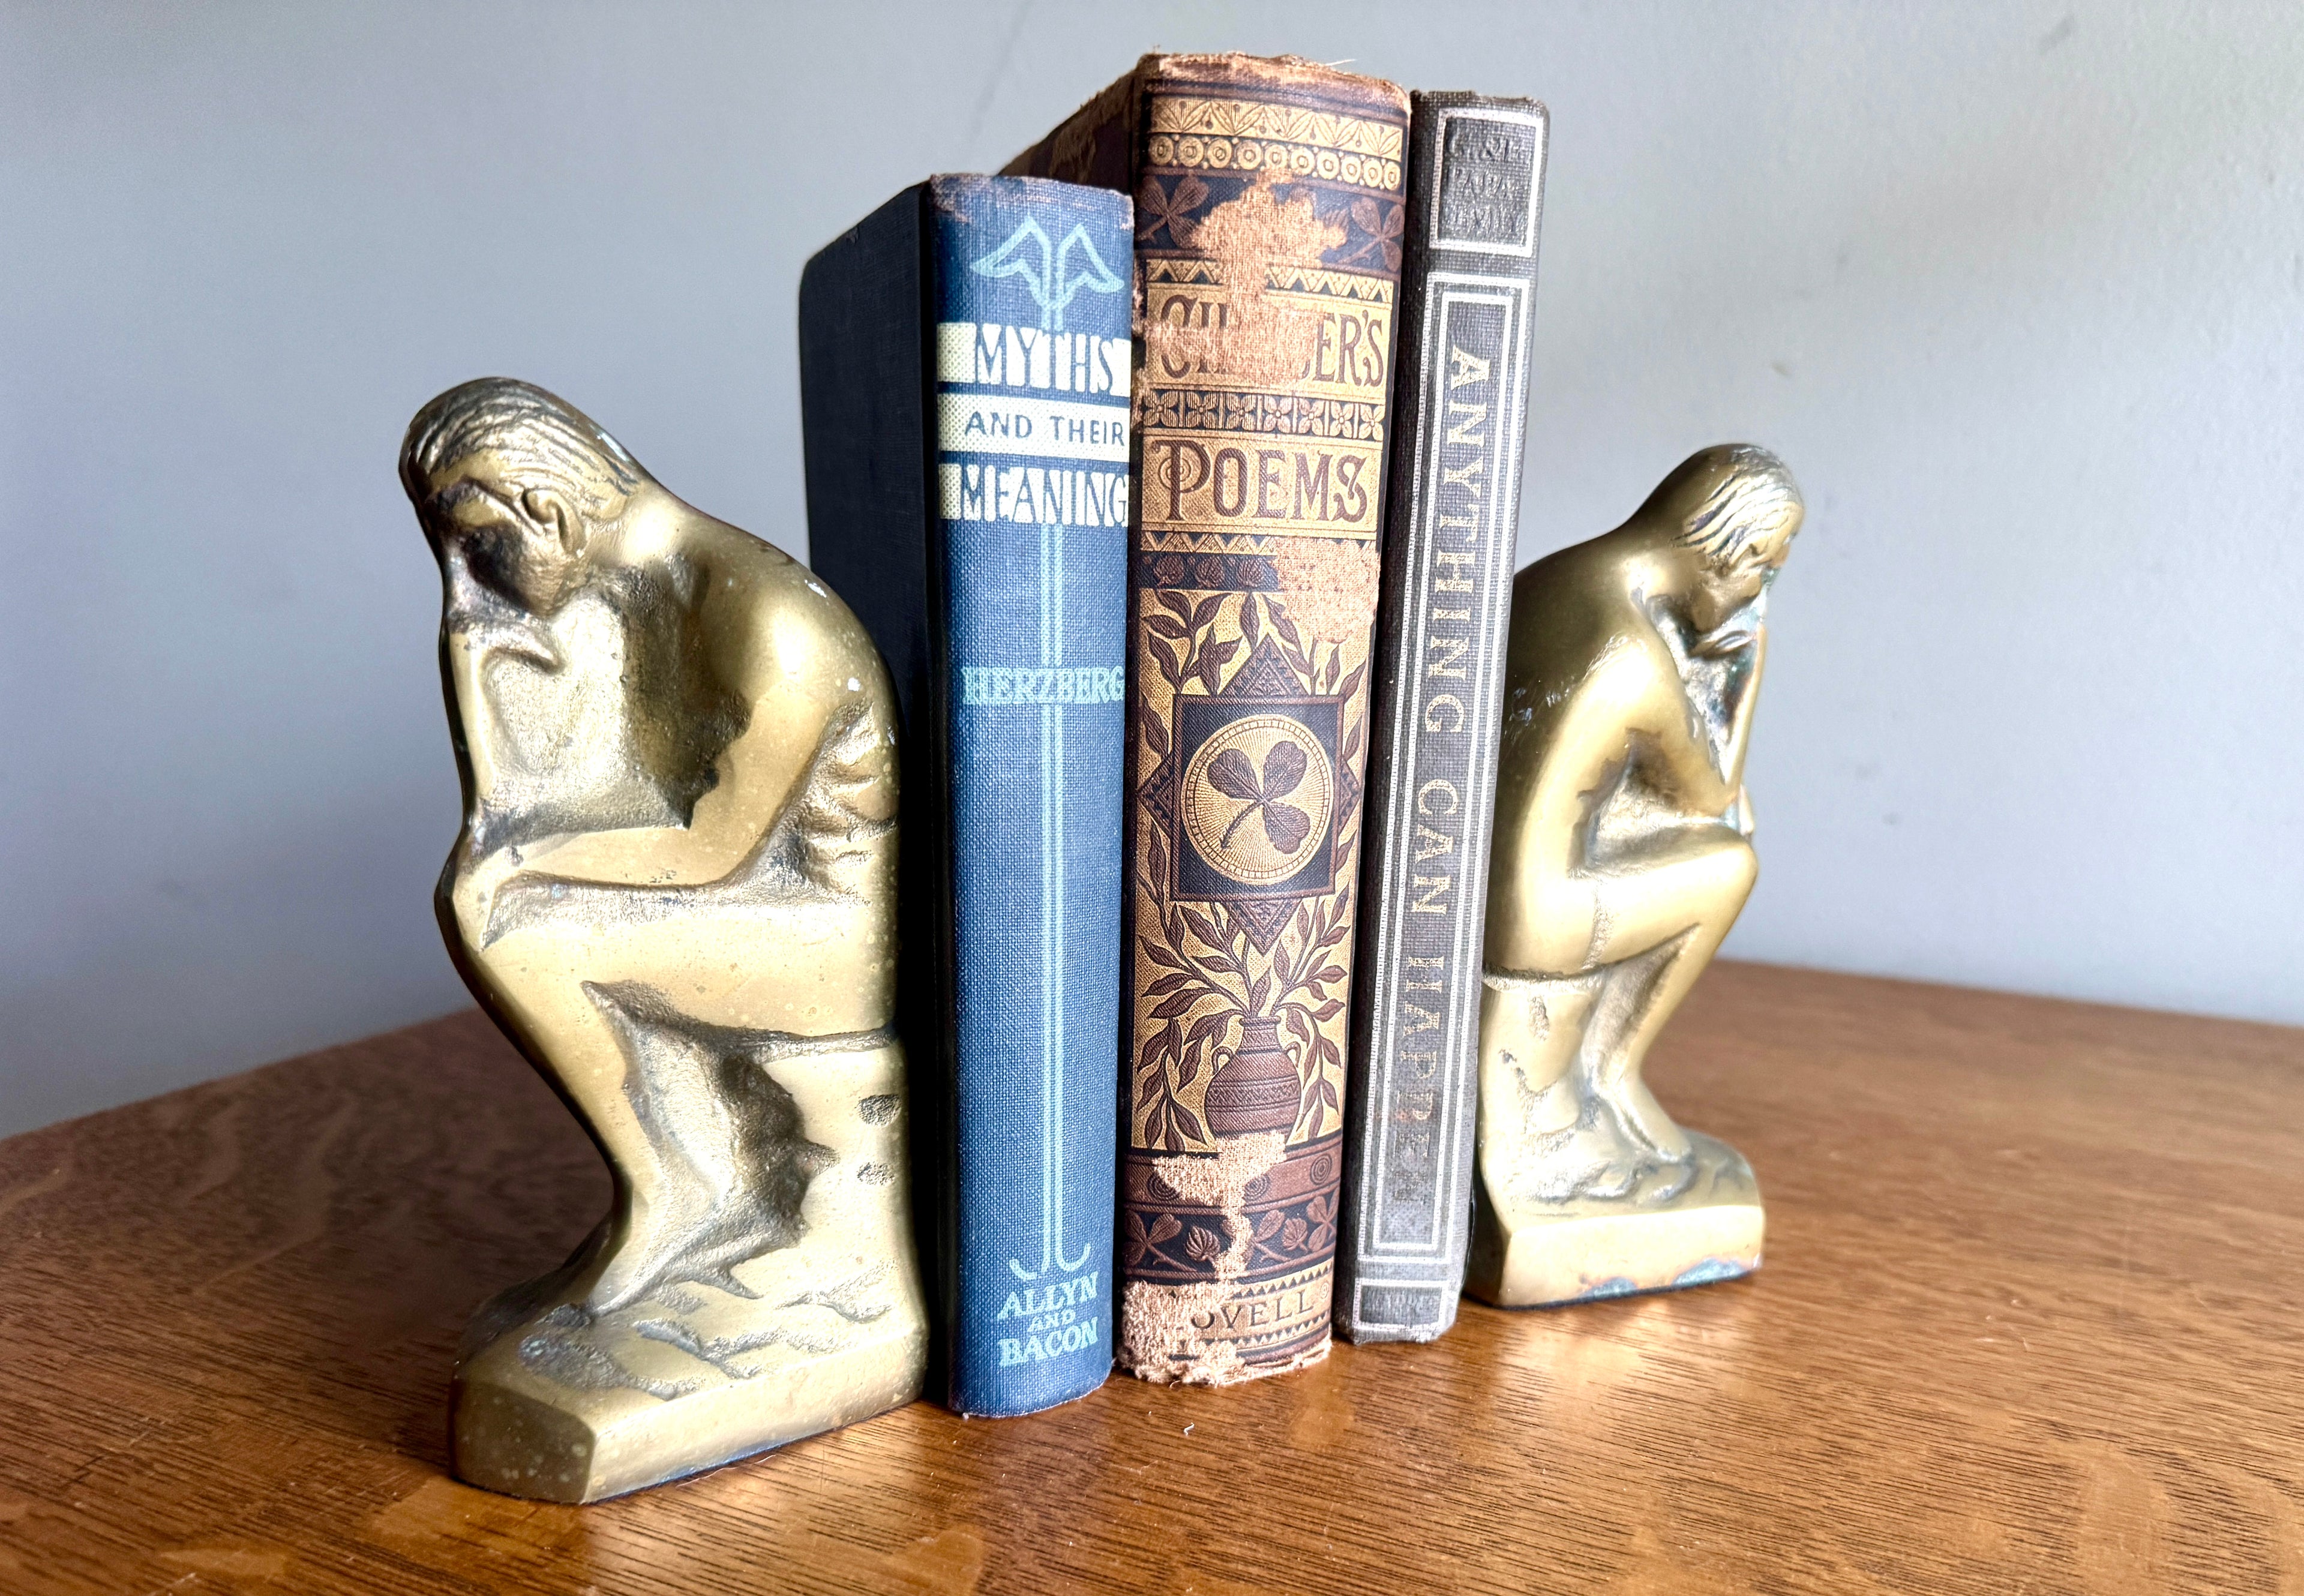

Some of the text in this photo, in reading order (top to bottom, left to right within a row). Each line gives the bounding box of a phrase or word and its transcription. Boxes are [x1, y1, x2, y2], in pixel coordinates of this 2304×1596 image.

[974, 323, 1114, 394] MYTHS
[964, 410, 1125, 447] AND THEIR
[960, 464, 1129, 527] MEANING
[1151, 439, 1369, 523] POEMS
[1424, 345, 1490, 733] ANYTHING
[961, 665, 1125, 705] HERZBERG
[1411, 779, 1458, 915] CAN
[997, 1271, 1099, 1321] ALLYN
[1027, 1309, 1076, 1333] AND
[1189, 1288, 1315, 1331] OVELL
[997, 1316, 1099, 1367] BACON
